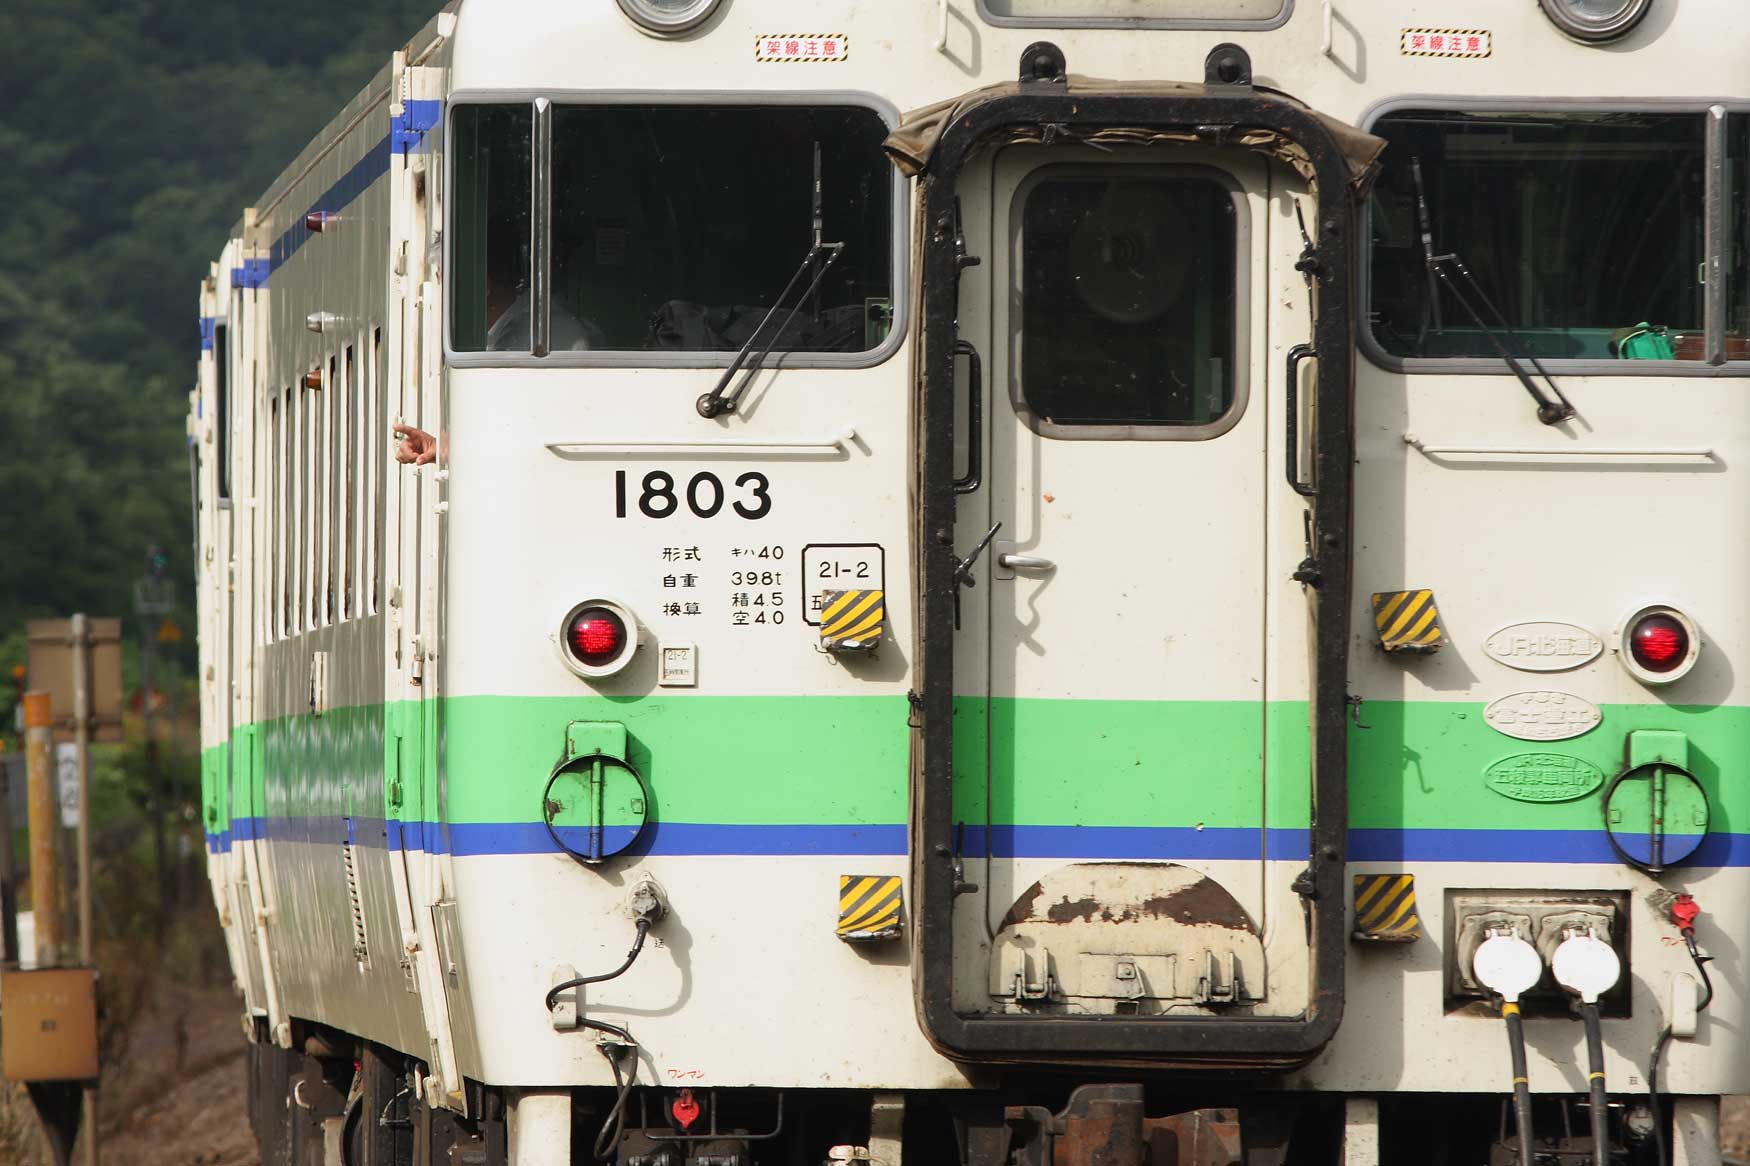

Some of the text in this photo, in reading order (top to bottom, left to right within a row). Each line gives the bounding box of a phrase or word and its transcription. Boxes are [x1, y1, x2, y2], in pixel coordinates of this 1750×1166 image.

[767, 40, 837, 56] 架線注意
[1411, 34, 1481, 52] 架線注意
[616, 470, 771, 519] 1803
[663, 545, 784, 563] 形式 キハ40
[819, 561, 869, 578] 21-2
[664, 574, 698, 588] 自重
[663, 601, 701, 617] 換算
[667, 1069, 705, 1079] ワンマン
